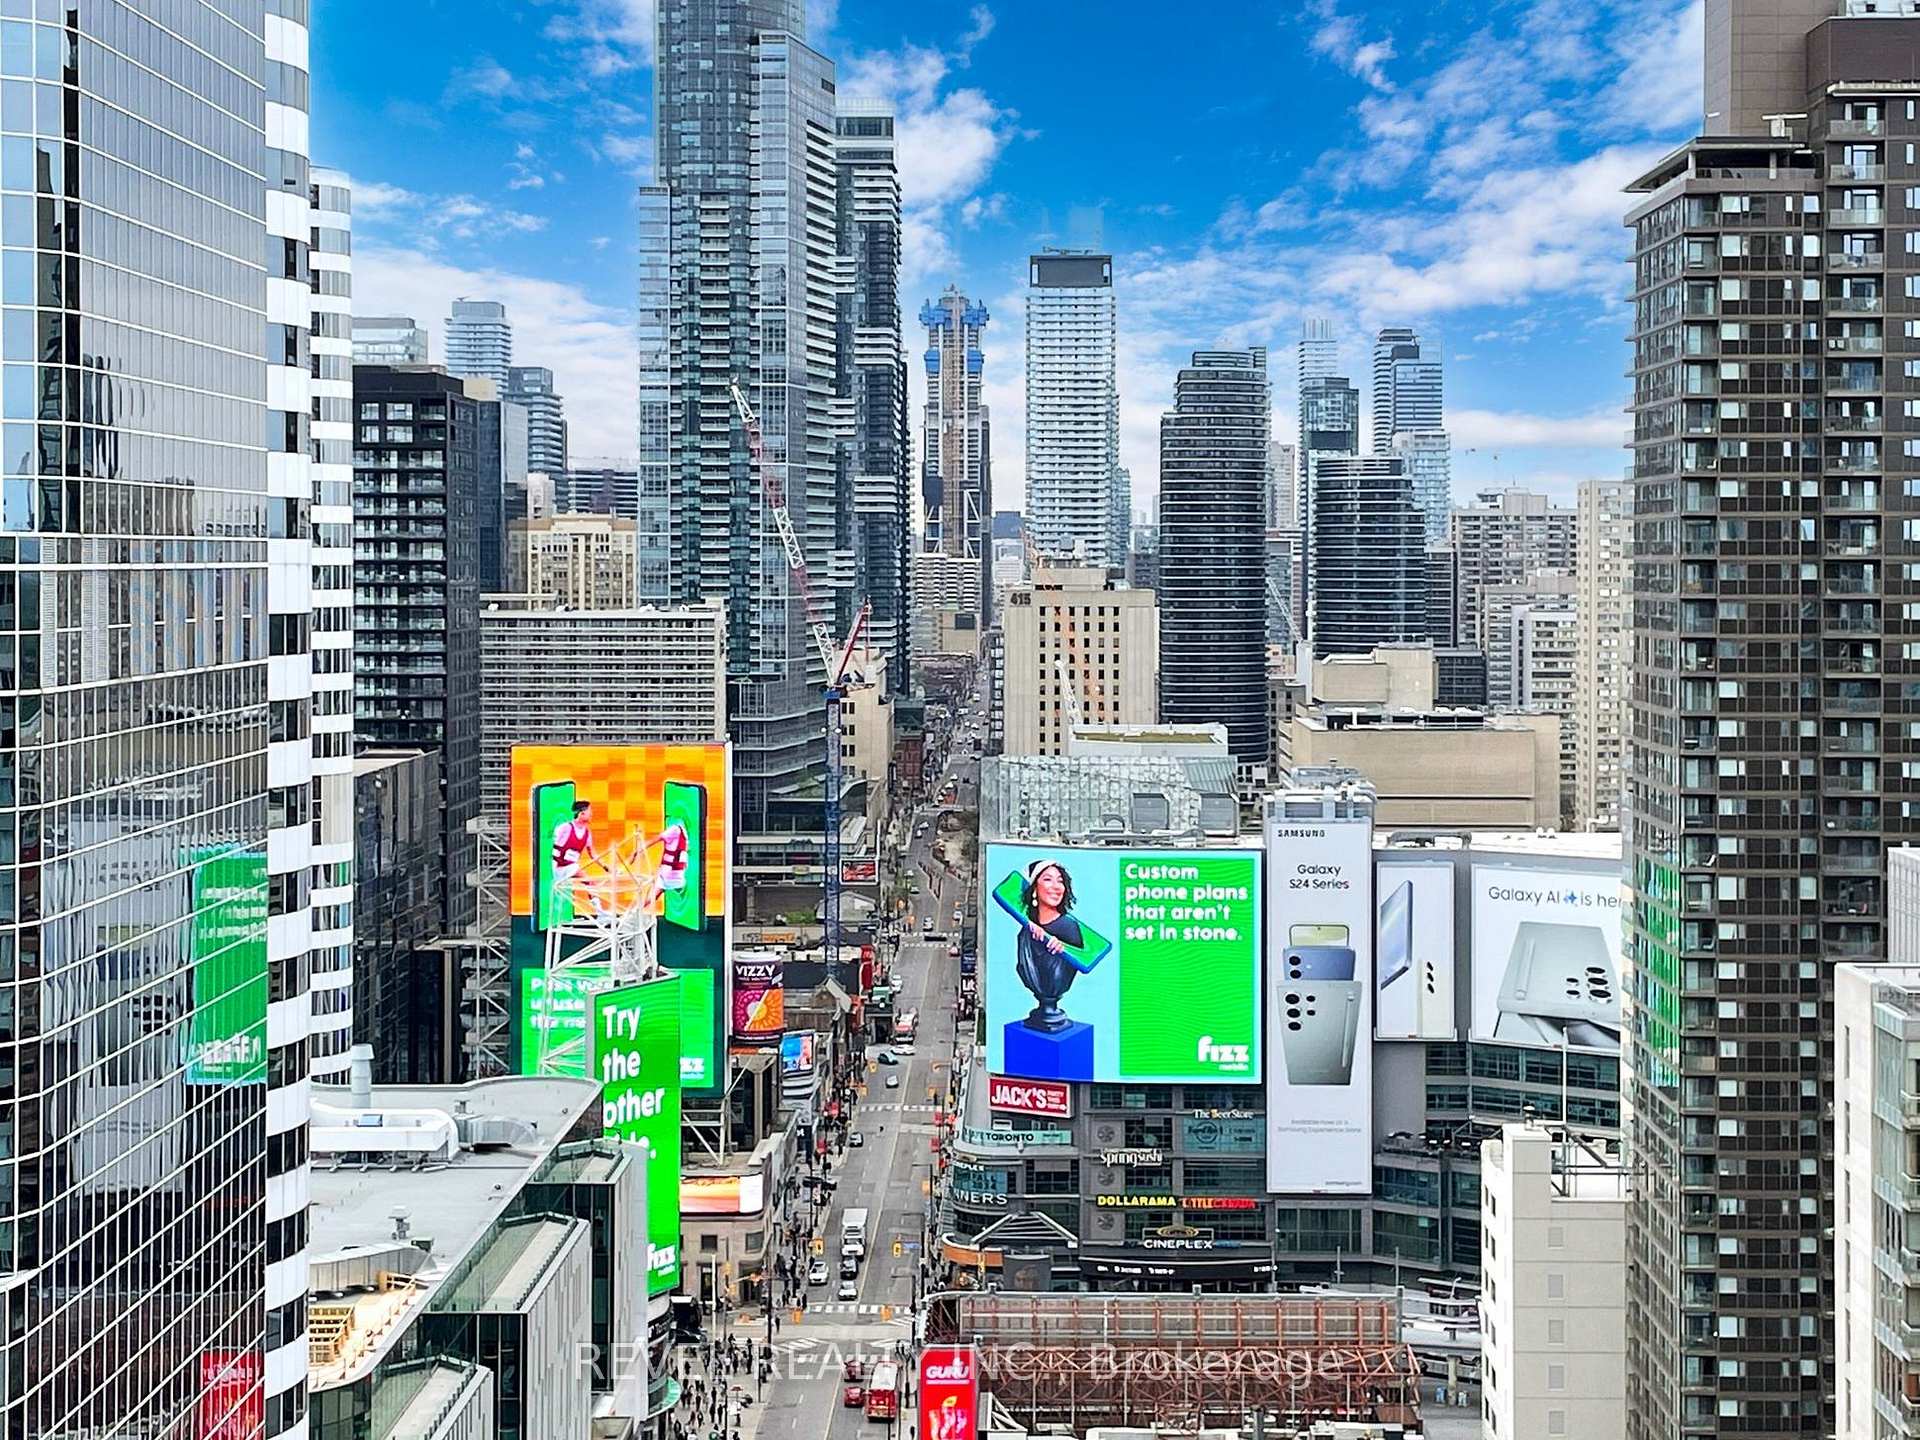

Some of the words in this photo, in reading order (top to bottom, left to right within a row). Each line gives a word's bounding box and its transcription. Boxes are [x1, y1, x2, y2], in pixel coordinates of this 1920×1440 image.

[1010, 593, 1031, 605] 415
[1278, 829, 1325, 838] SAMSUNG
[1125, 863, 1199, 880] Custom
[1297, 864, 1341, 877] Galaxy
[1289, 878, 1309, 889] S24
[1312, 878, 1350, 889] Series
[1125, 884, 1188, 904] phone
[1193, 884, 1249, 904] plans
[1488, 886, 1543, 906] Galaxy
[1547, 890, 1560, 904] AI
[1581, 891, 1592, 906] is
[1125, 904, 1165, 920] that
[1170, 904, 1231, 921] aren't
[1125, 924, 1154, 940] set
[1160, 923, 1177, 940] in
[1183, 924, 1243, 941] stone.
[736, 964, 776, 977] VIZZY
[602, 1004, 641, 1041] Try
[1197, 1036, 1249, 1062] fizz
[602, 1049, 641, 1084] the
[991, 1084, 1047, 1109] JACK'S
[602, 1087, 666, 1129] other
[986, 1132, 1034, 1142] TORONTO
[1097, 1195, 1176, 1207] DOLLARAMA
[1143, 1239, 1213, 1250] CINEPLEX
